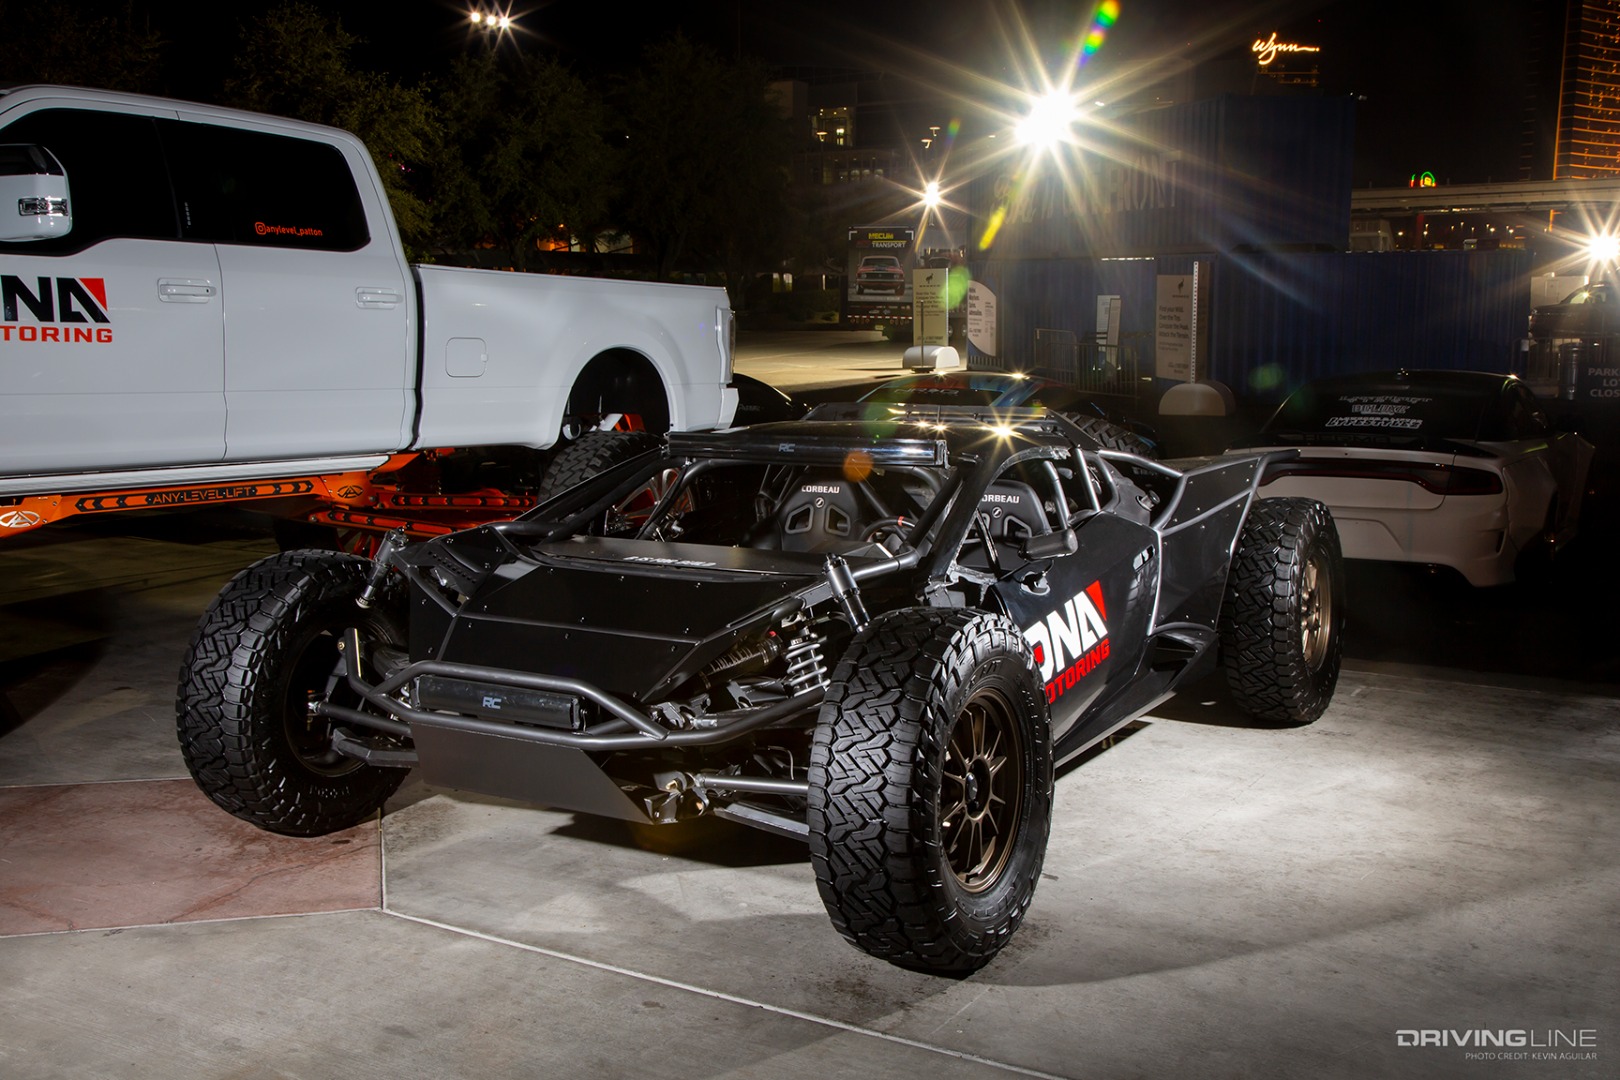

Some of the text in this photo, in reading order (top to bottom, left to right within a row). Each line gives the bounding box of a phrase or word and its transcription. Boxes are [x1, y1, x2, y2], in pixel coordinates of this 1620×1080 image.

[1602, 378, 1620, 388] LO
[777, 442, 796, 453] RC
[152, 486, 252, 504] ANY LEVEL LIFT
[801, 485, 840, 494] CORBEAU
[482, 696, 502, 709] RC
